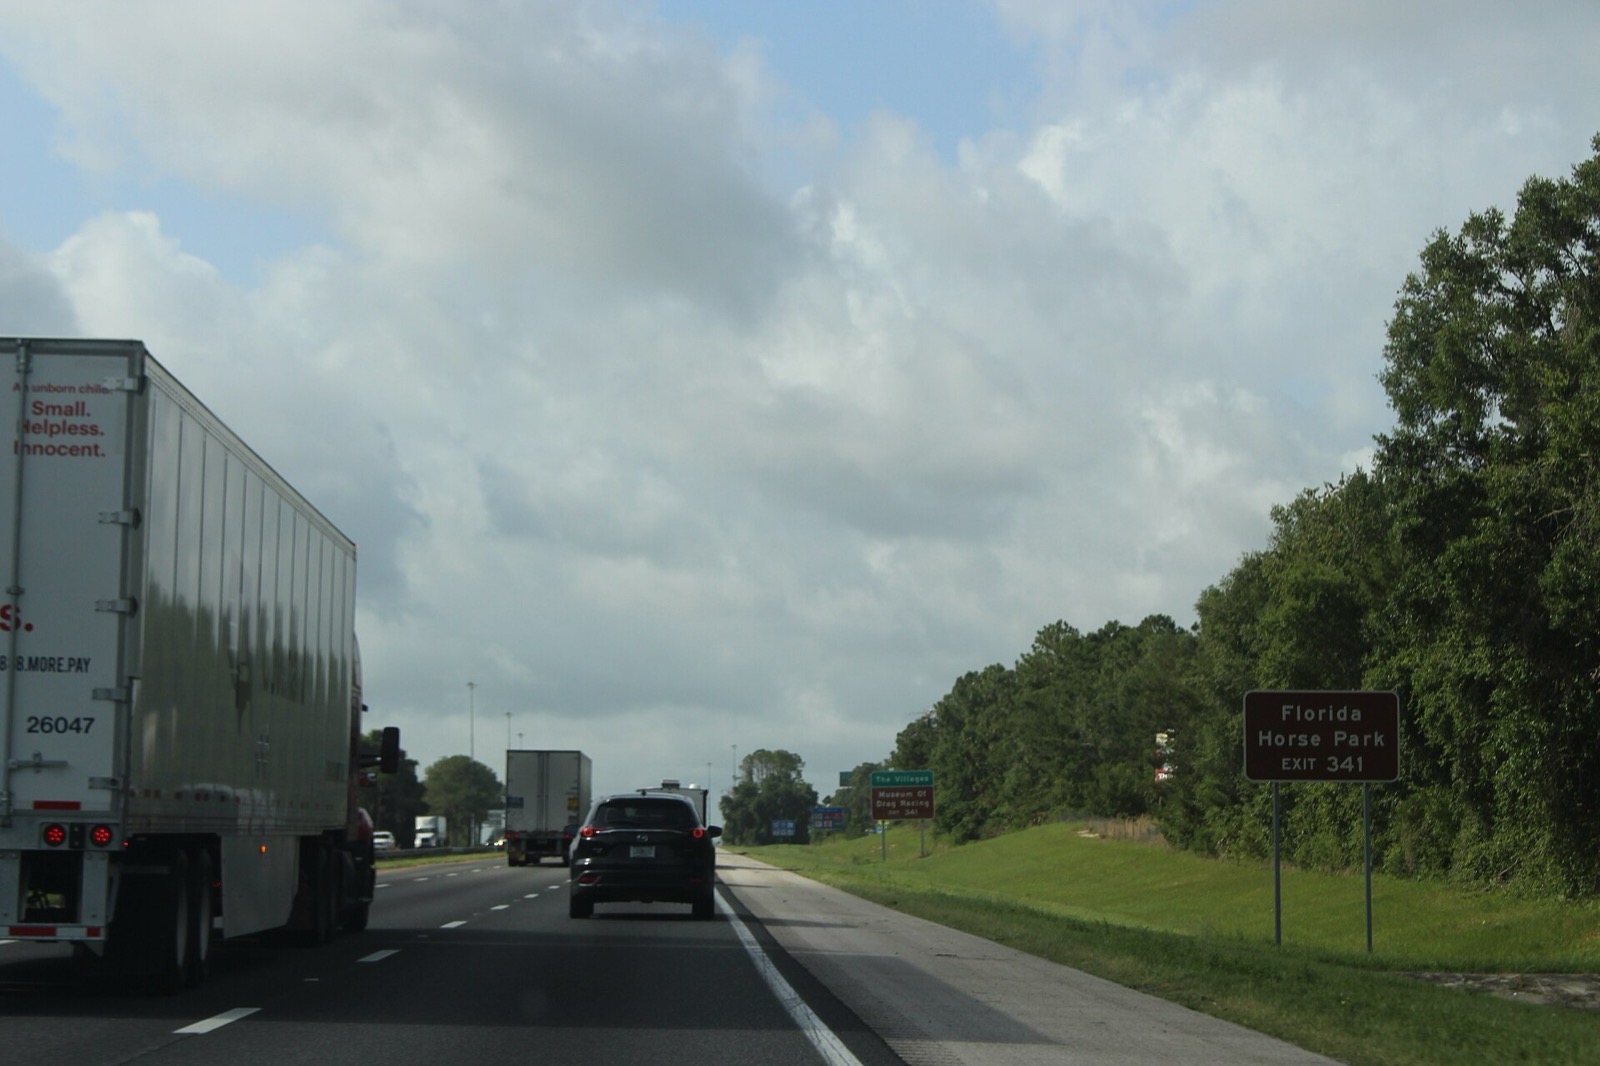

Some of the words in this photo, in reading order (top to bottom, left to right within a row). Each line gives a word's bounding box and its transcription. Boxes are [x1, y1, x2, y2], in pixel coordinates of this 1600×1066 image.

[32, 382, 76, 394] unborn
[32, 400, 91, 418] Small.
[17, 419, 105, 438] Helpless.
[13, 440, 106, 458] Innocent.
[0, 655, 91, 673] 88.MORE.PAY
[1282, 705, 1362, 721] Florida
[27, 716, 95, 734] 26047
[1258, 730, 1321, 746] Horse
[1334, 731, 1385, 746] Park
[1282, 758, 1316, 770] EXIT
[1327, 756, 1363, 772] 341
[895, 776, 929, 784] Villages
[876, 800, 897, 808] Drag
[900, 800, 929, 808] Racing
